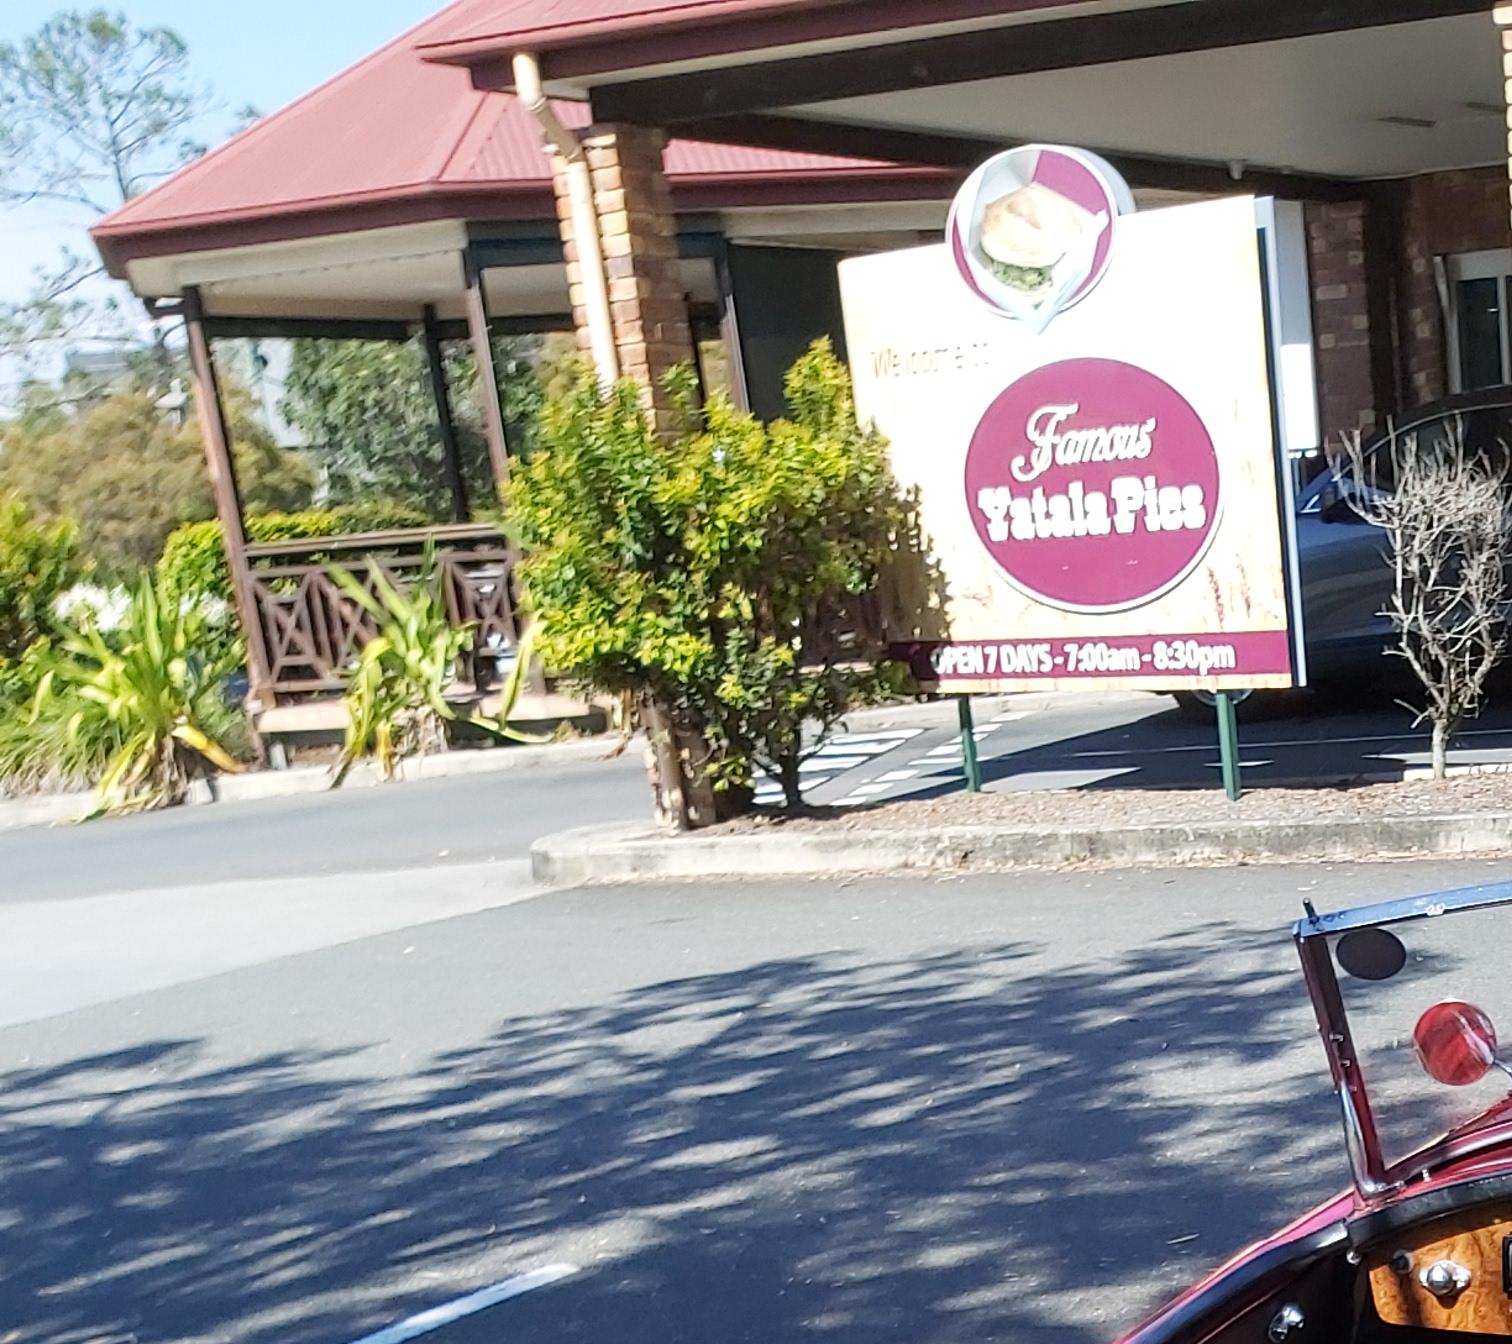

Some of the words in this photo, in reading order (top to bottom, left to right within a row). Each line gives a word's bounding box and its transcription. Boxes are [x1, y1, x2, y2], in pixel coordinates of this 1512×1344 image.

[1010, 402, 1157, 482] Famous
[977, 480, 1112, 542] Yatala
[1110, 475, 1207, 535] Pies
[930, 645, 983, 674] OPEN
[984, 646, 999, 673] 7
[1000, 642, 1054, 673] DAYS
[1064, 643, 1141, 672] 7:00am
[1153, 640, 1236, 676] 8:30pm
